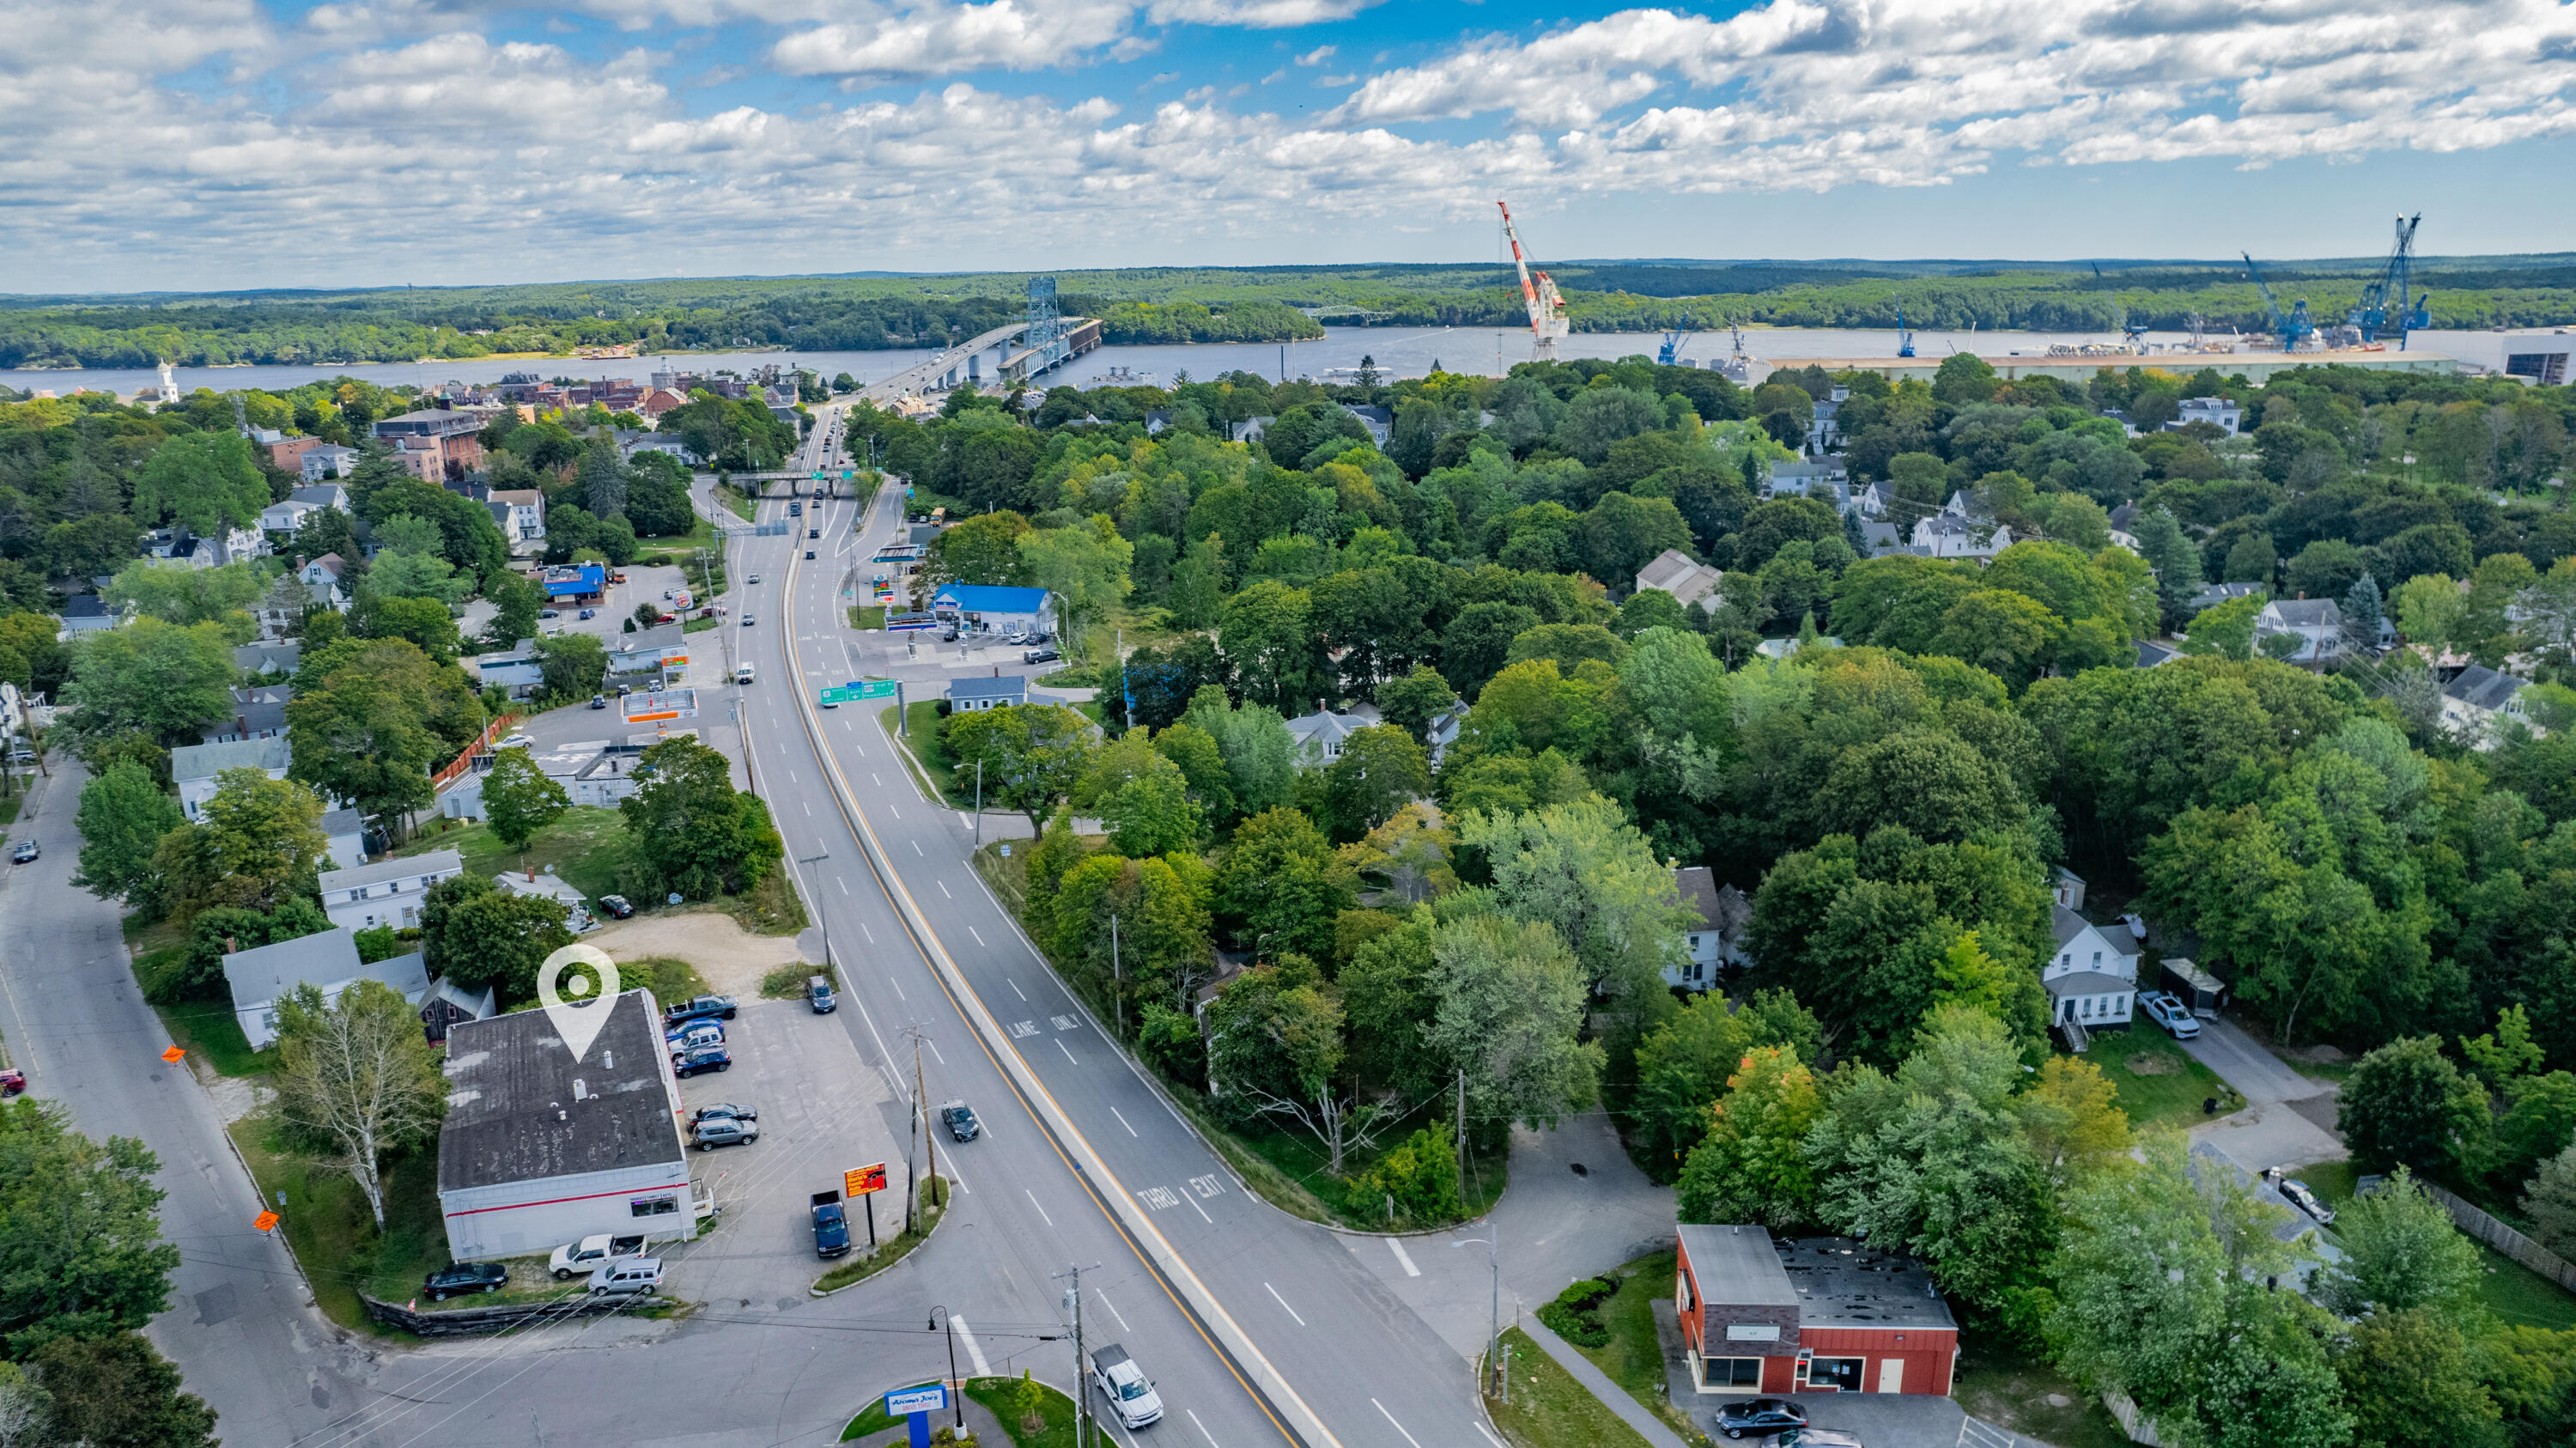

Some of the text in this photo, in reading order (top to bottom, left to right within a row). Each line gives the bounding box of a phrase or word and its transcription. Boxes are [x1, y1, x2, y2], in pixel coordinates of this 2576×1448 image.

[1006, 1013, 1083, 1039] LANE ONLY
[1137, 1173, 1226, 1212] THRU EXIT
[893, 1397, 919, 1406] Aroma
